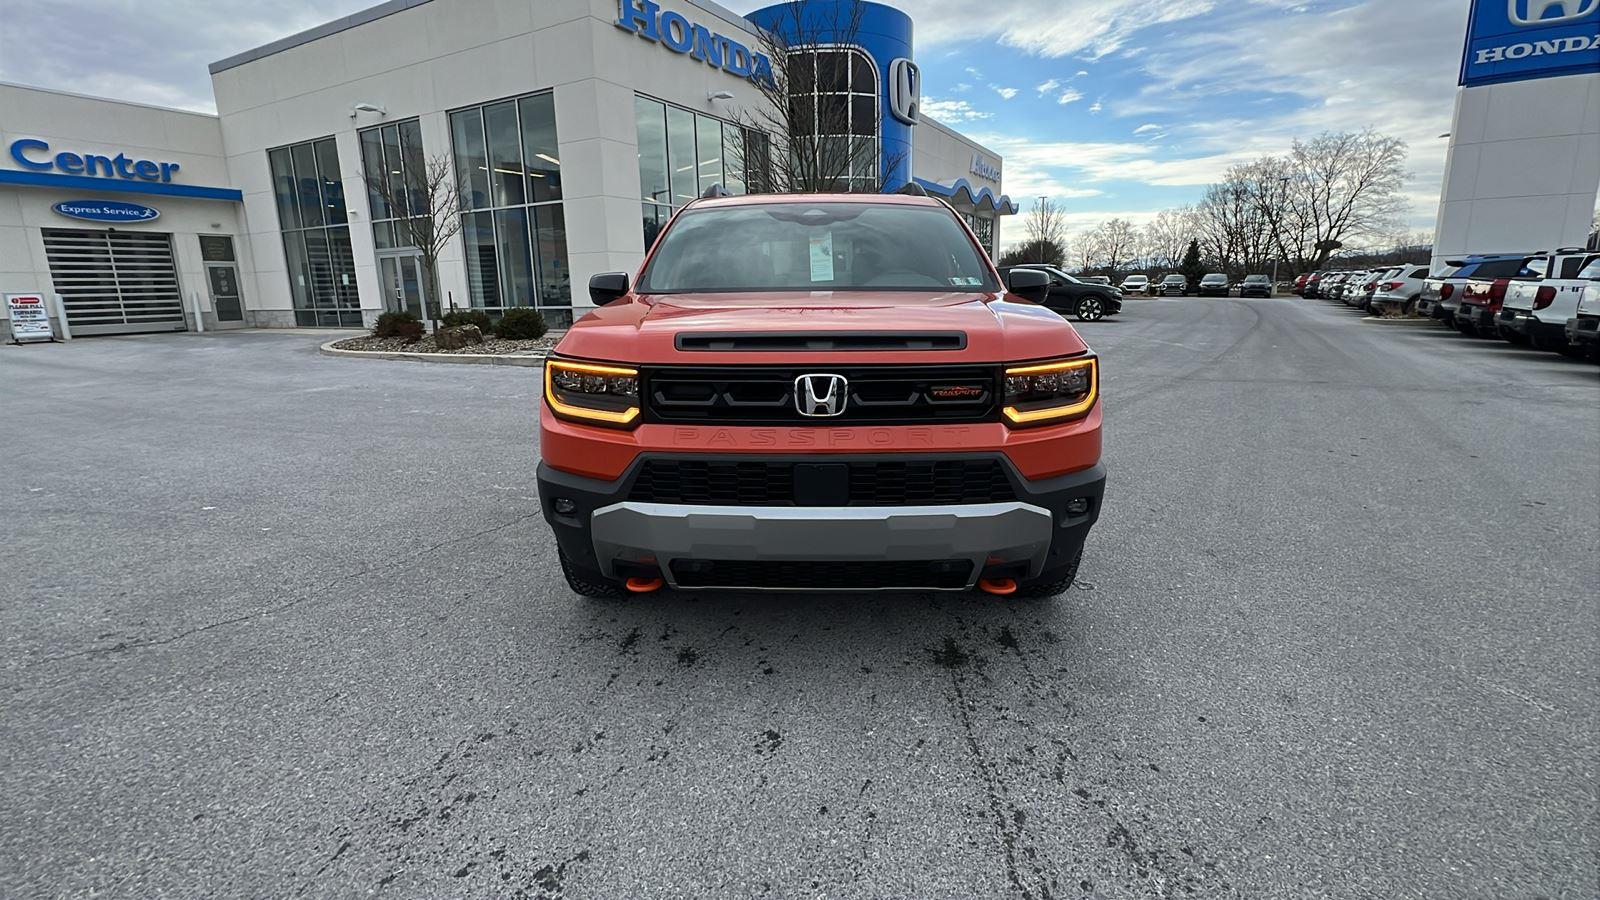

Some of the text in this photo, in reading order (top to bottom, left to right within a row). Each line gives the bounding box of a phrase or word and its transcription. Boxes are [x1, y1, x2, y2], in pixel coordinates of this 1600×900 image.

[614, 0, 778, 91] HONDA
[9, 139, 180, 183] Center
[60, 204, 139, 216] Express Service
[672, 426, 970, 447] PASSPORT
